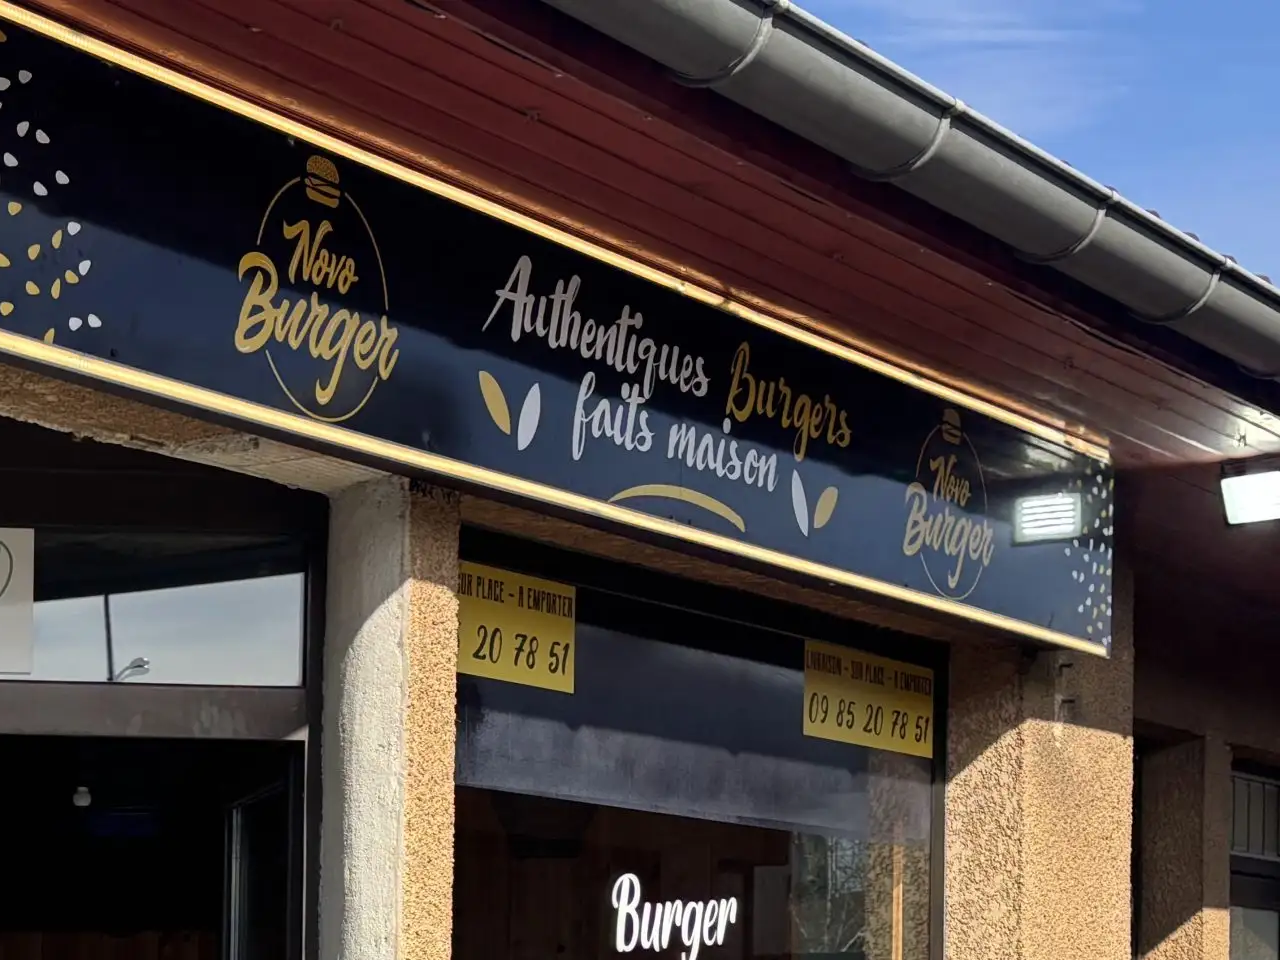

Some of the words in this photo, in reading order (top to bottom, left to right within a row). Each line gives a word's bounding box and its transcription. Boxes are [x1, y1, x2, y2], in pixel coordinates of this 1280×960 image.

[283, 219, 359, 295] Novo
[234, 251, 399, 406] Burger
[482, 254, 711, 400] Authentiques
[725, 341, 852, 462] Burgers
[572, 371, 655, 461] faits
[667, 417, 780, 492] maison
[929, 454, 972, 506] Novo
[903, 481, 995, 588] Burger
[476, 575, 505, 604] PLACE
[527, 587, 573, 619] EMPORTER
[472, 624, 503, 664] 20
[514, 633, 539, 670] 78
[548, 641, 570, 676] 51
[809, 692, 829, 724] 09
[836, 698, 856, 729] 85
[862, 704, 884, 736] 20
[891, 710, 909, 740] 78
[914, 715, 930, 744] 51
